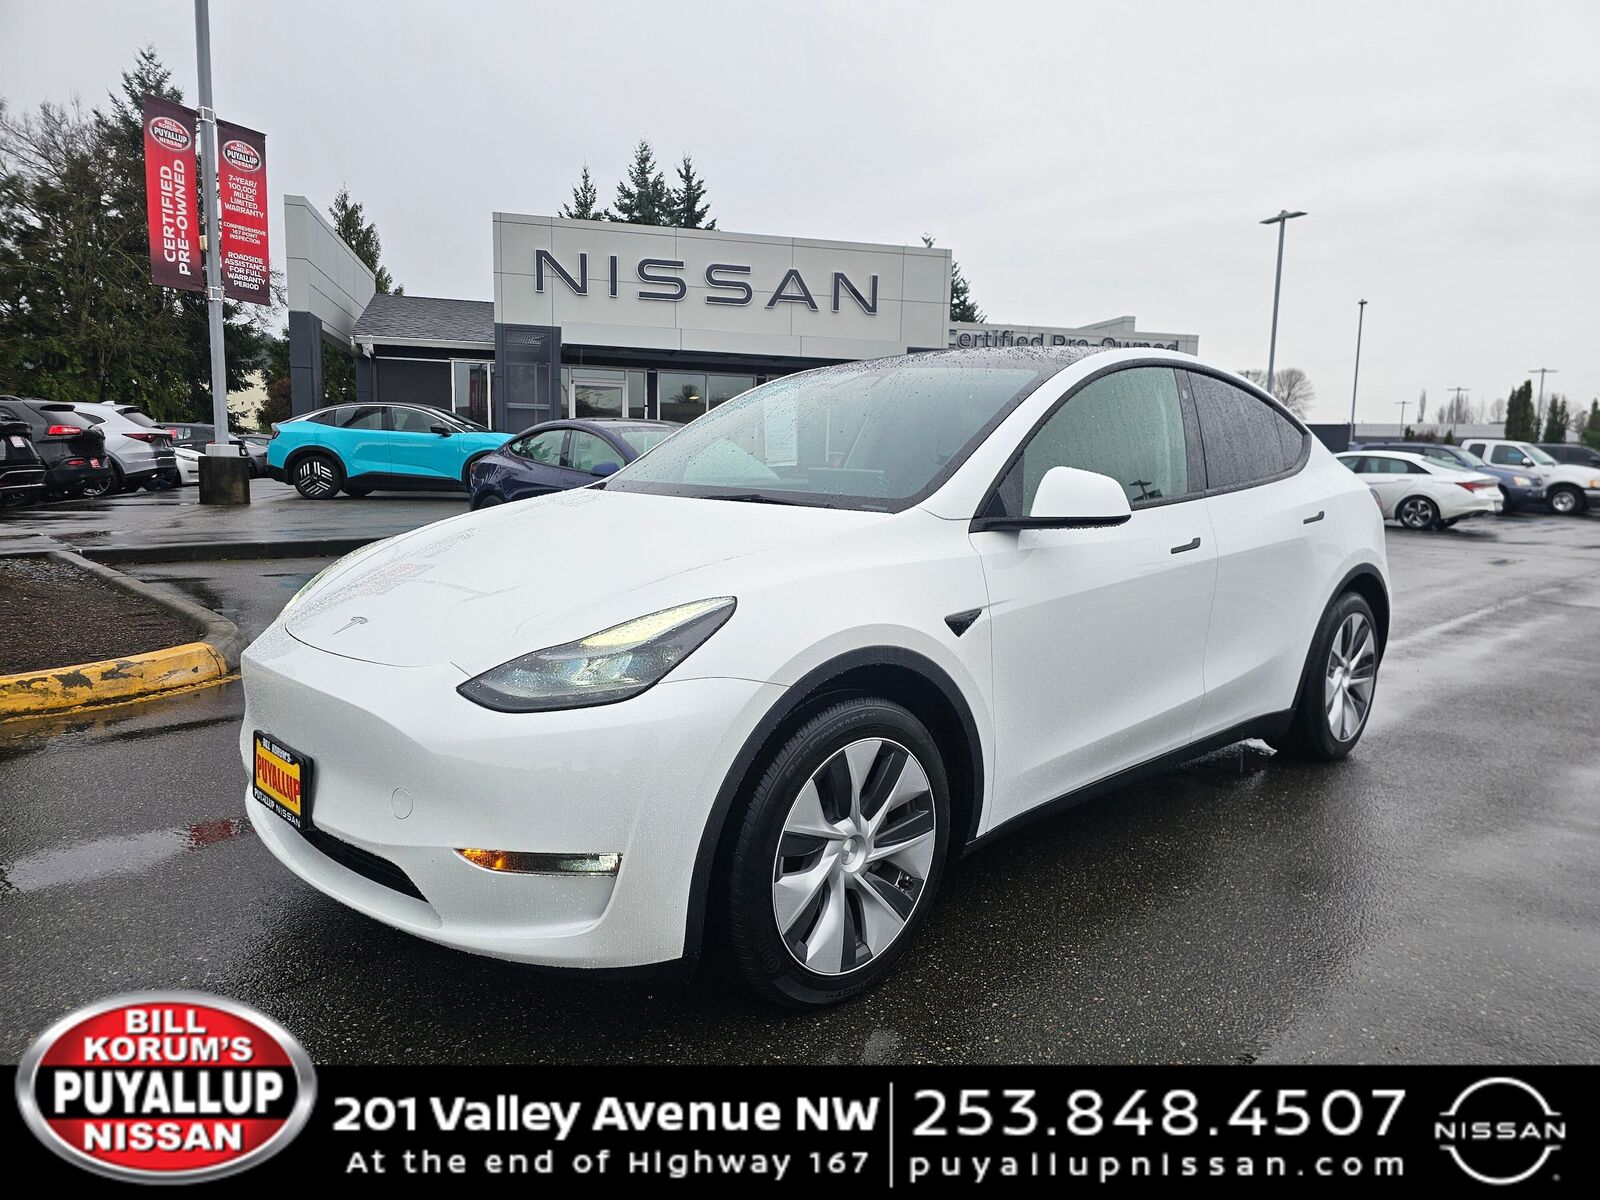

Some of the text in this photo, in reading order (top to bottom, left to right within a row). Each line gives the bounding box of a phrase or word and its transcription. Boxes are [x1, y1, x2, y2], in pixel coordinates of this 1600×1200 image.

[154, 126, 188, 144] PUYALLUP
[227, 149, 258, 165] PUYALLUP
[228, 174, 257, 189] 7-YEAR/
[228, 182, 257, 195] 100,000
[230, 196, 258, 210] LIMITED
[233, 190, 255, 203] MILES
[160, 166, 176, 263] CERTIFIED
[174, 159, 191, 276] PRE-OWNED
[224, 202, 264, 219] WARRANTY
[224, 257, 267, 272] ASSISTANCE
[228, 251, 264, 265] ROADSIDE
[227, 271, 266, 285] WARRANTY
[229, 265, 262, 278] FOR FULL
[233, 279, 260, 291] PERIOD
[535, 249, 879, 315] NISSAN
[257, 752, 301, 806] PUYALLUP
[275, 803, 302, 829] NISSAN
